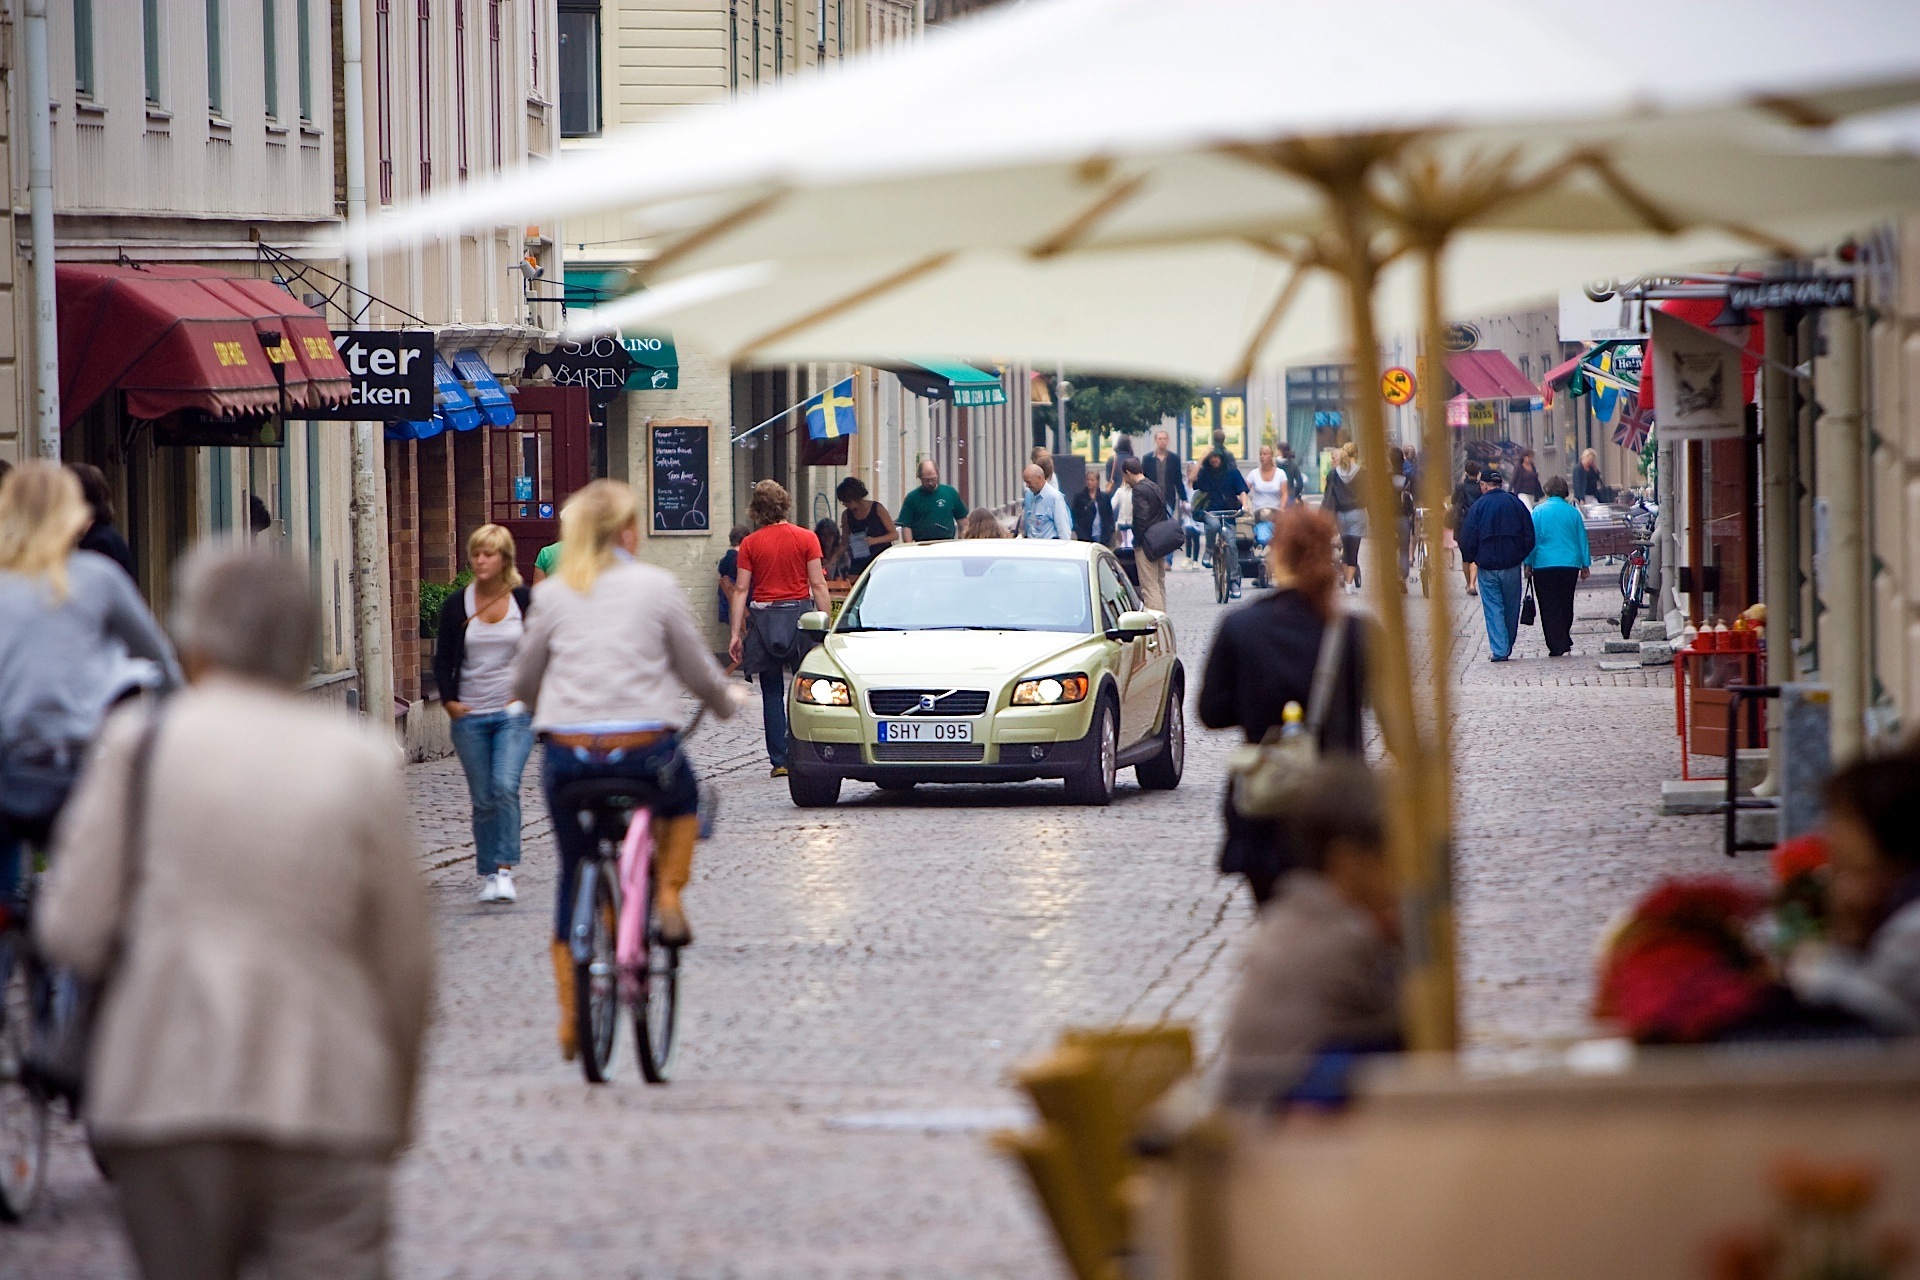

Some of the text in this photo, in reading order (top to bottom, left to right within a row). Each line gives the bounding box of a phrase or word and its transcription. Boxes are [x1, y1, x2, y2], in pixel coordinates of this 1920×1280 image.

[562, 334, 616, 358] SJÖ
[621, 338, 662, 351] LINO
[1618, 358, 1643, 369] Hein
[553, 363, 626, 390] BAREN
[889, 724, 968, 739] SHY 095
